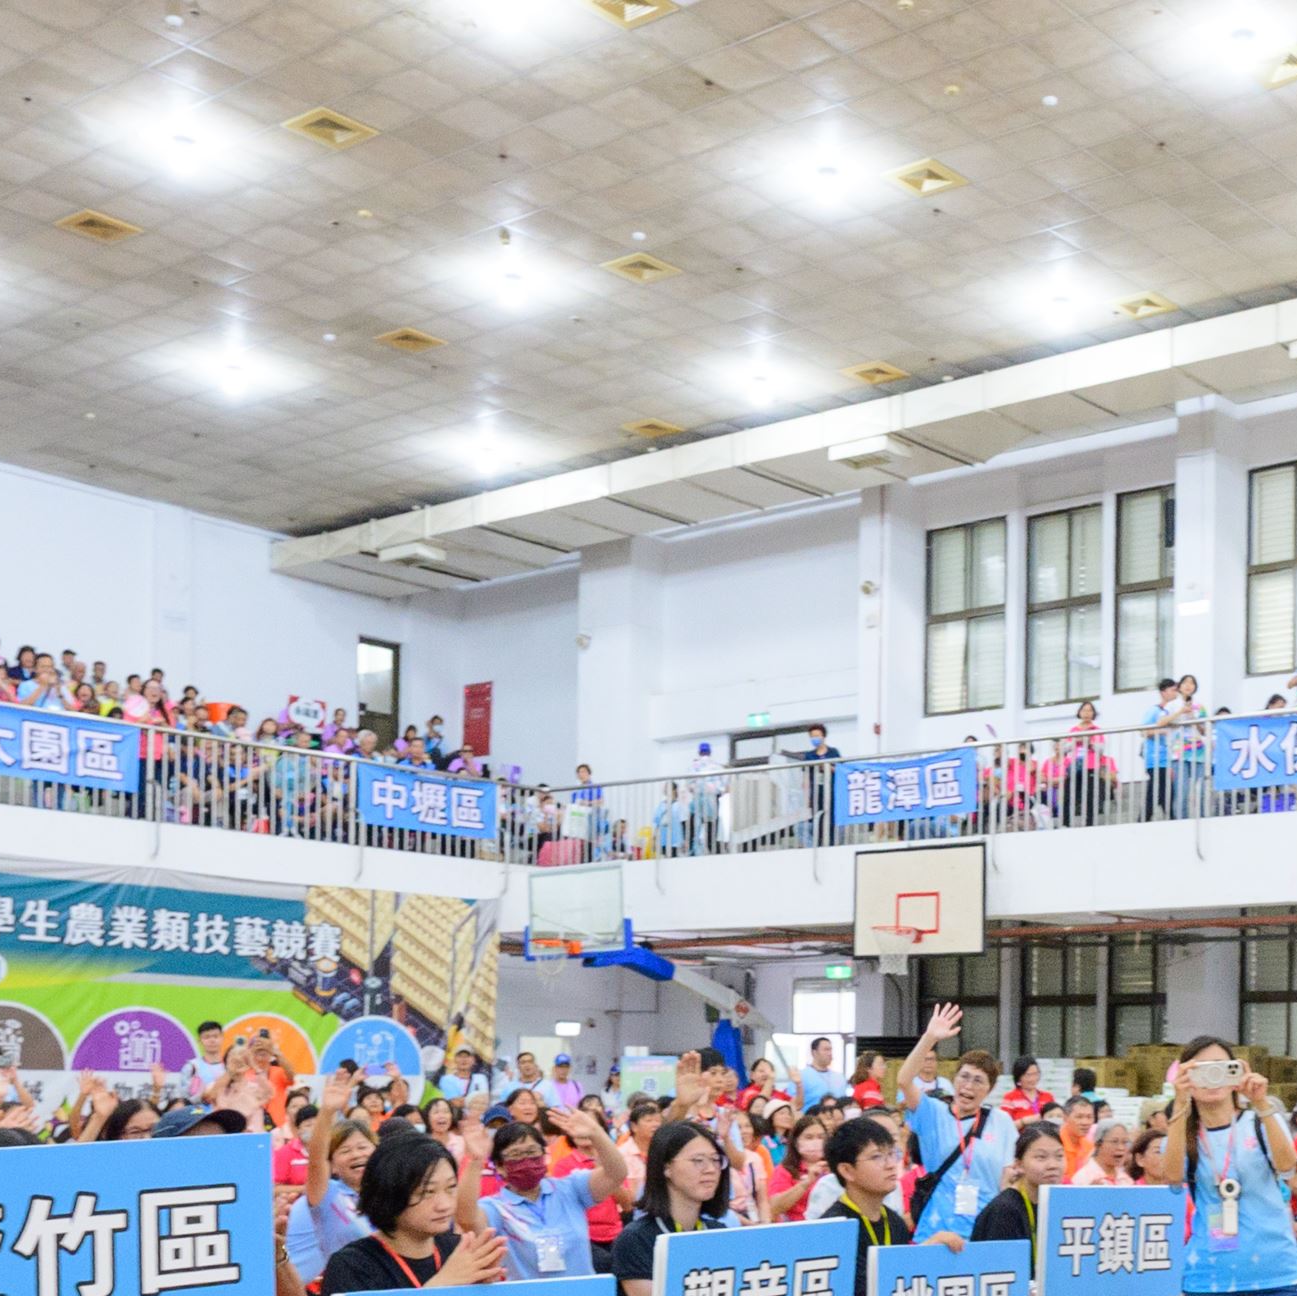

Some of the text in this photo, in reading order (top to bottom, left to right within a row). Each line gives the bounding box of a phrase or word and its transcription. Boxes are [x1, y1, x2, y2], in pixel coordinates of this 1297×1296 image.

[372, 774, 485, 829] 中壢區
[847, 758, 963, 816] 龍潭區
[1058, 1211, 1174, 1277] 平鎮區
